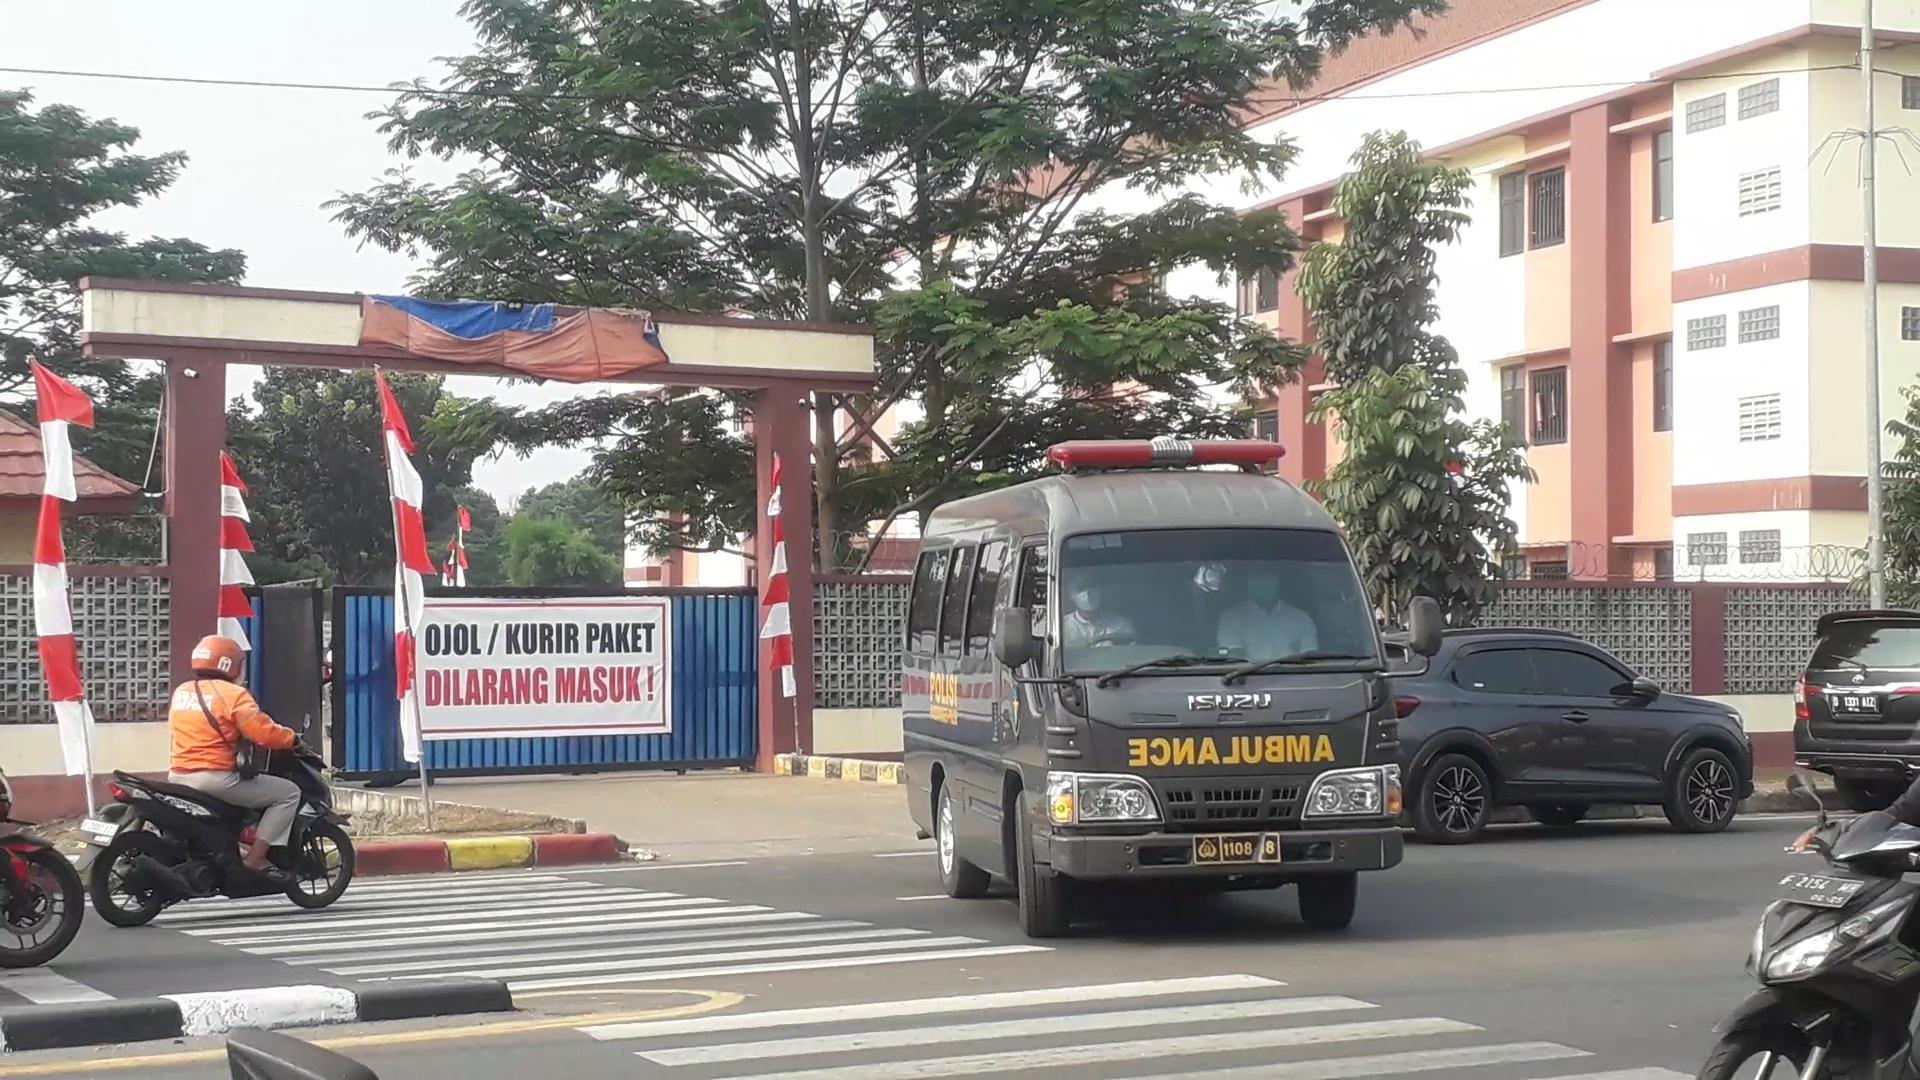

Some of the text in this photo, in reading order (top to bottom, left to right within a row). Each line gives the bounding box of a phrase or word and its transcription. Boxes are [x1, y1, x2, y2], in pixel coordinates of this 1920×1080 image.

[425, 622, 656, 656] OJOL / KURIR PAKET
[425, 667, 549, 706] DILARANG
[555, 666, 641, 704] MASUK
[929, 671, 958, 707] POLISI
[1188, 693, 1271, 711] ISUZU
[1223, 842, 1253, 857] 1108
